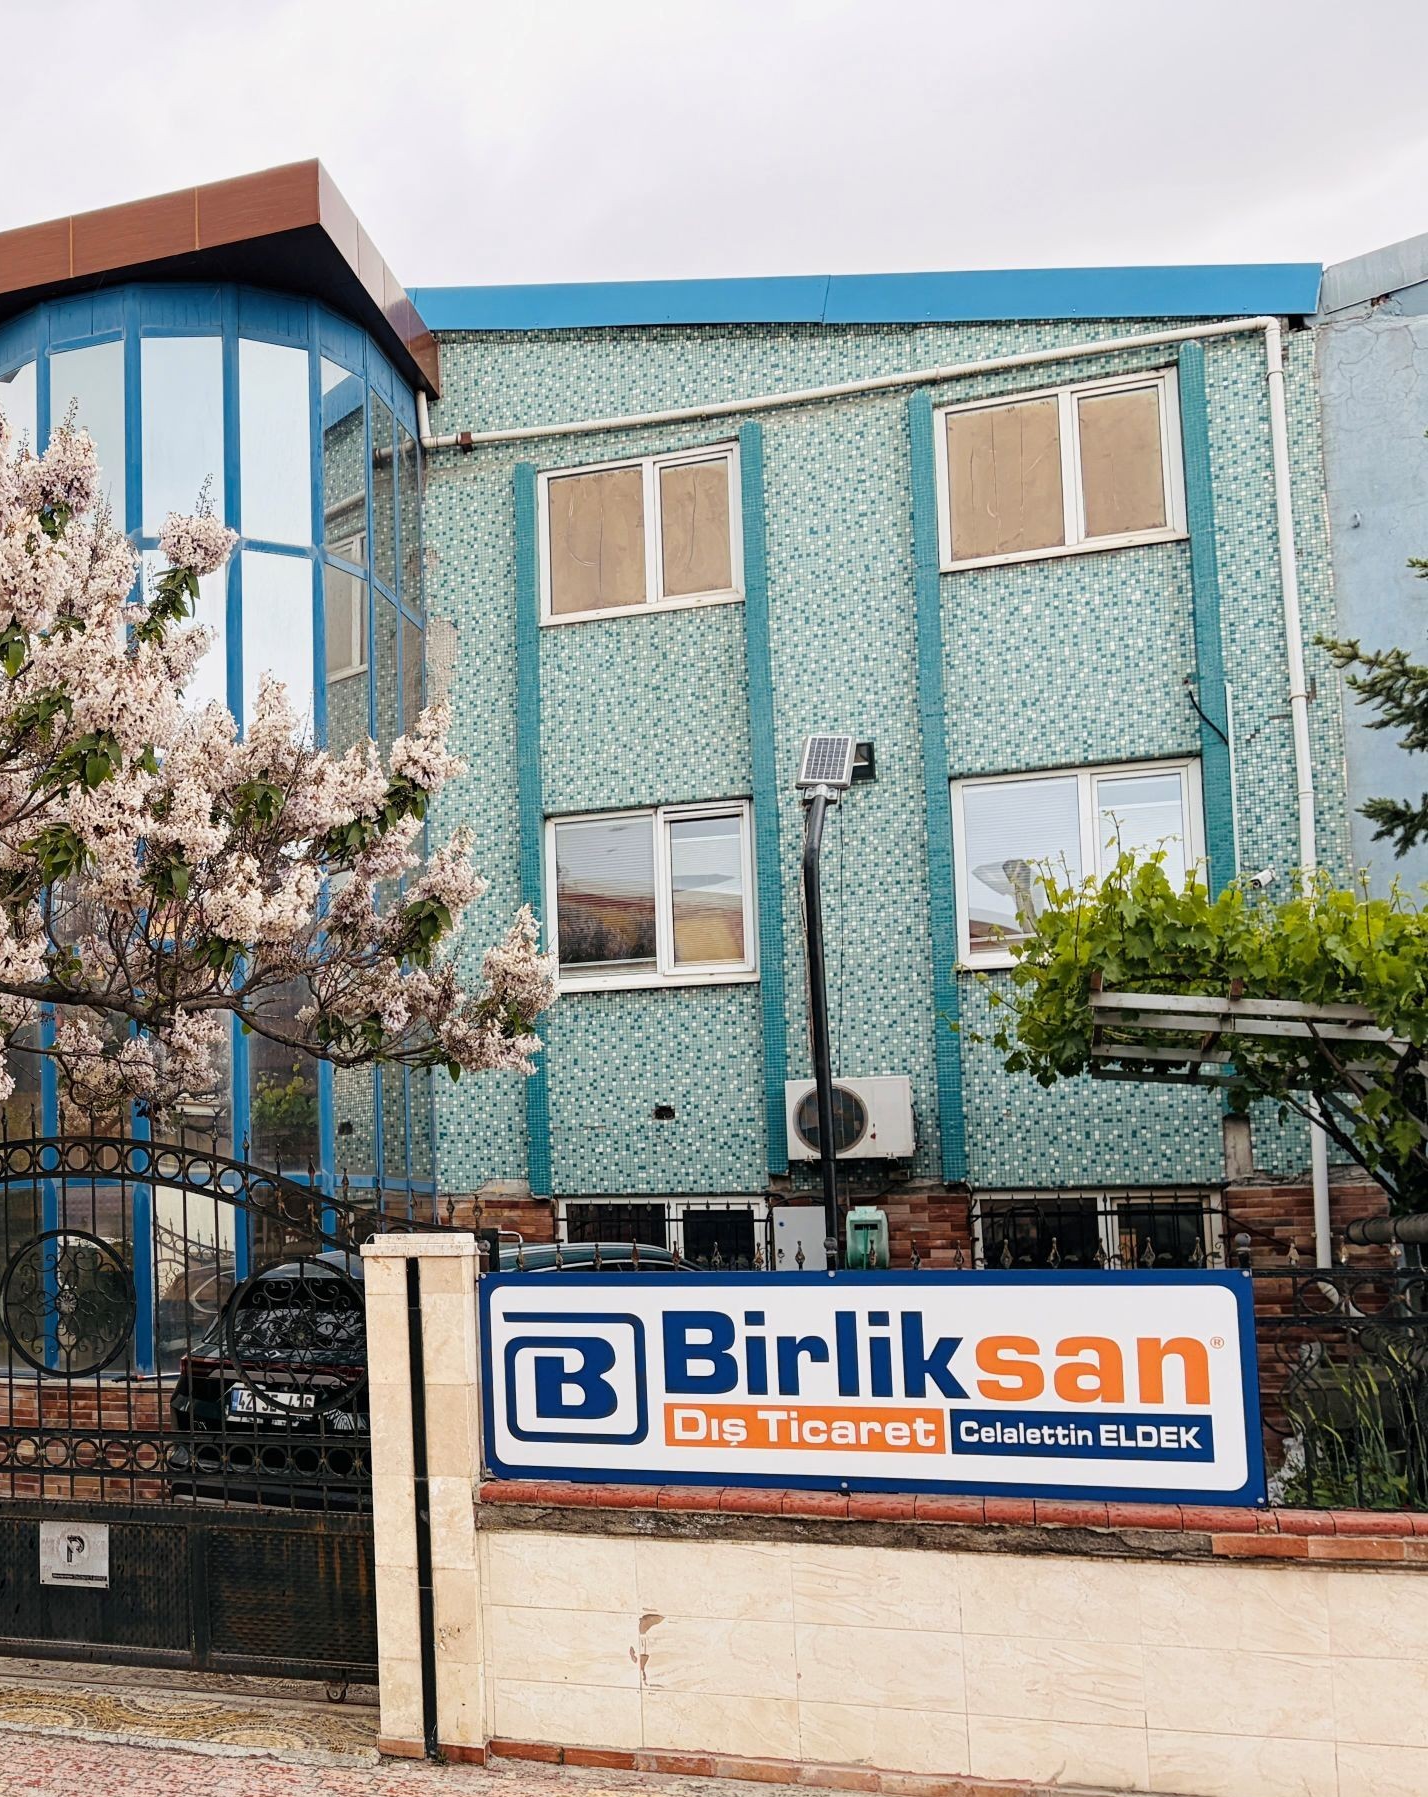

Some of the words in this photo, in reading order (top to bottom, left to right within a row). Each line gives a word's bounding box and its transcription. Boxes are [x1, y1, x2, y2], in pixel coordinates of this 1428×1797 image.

[238, 1391, 253, 1411] 42
[673, 1408, 748, 1447] Dış
[757, 1410, 937, 1447] Ticaret
[959, 1420, 1093, 1447] Celalettin
[1099, 1424, 1203, 1449] ELDEK
[66, 1534, 85, 1563] P
